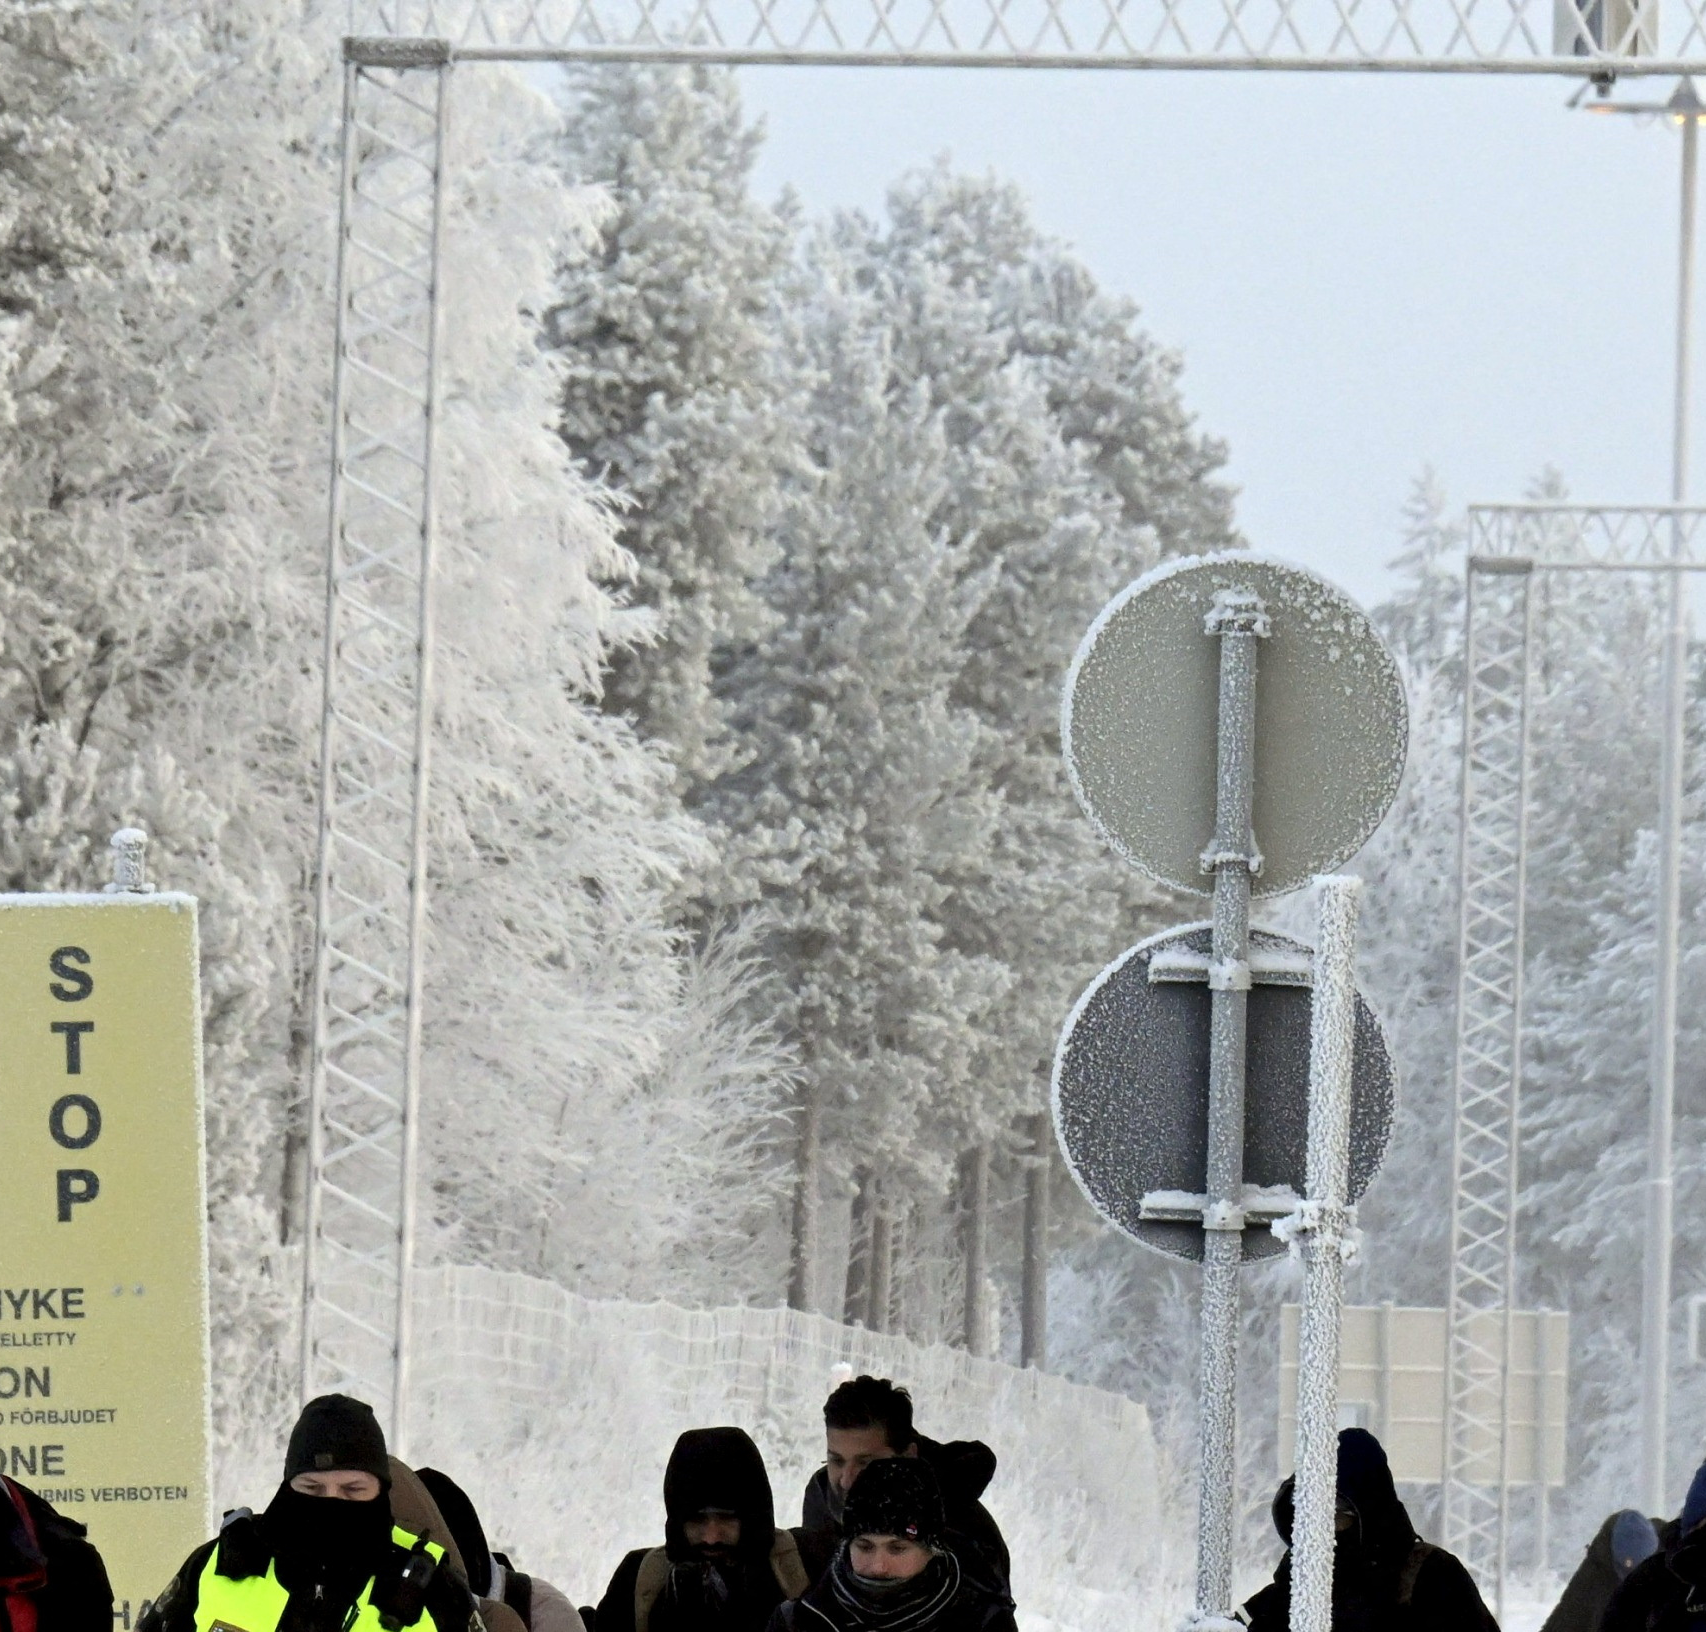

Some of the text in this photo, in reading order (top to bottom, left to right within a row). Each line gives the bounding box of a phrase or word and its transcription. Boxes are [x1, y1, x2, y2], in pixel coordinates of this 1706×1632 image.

[49, 945, 102, 1222] STOP
[10, 1407, 117, 1425] FÖRBJUDET
[91, 1486, 188, 1502] VERBOTEN
